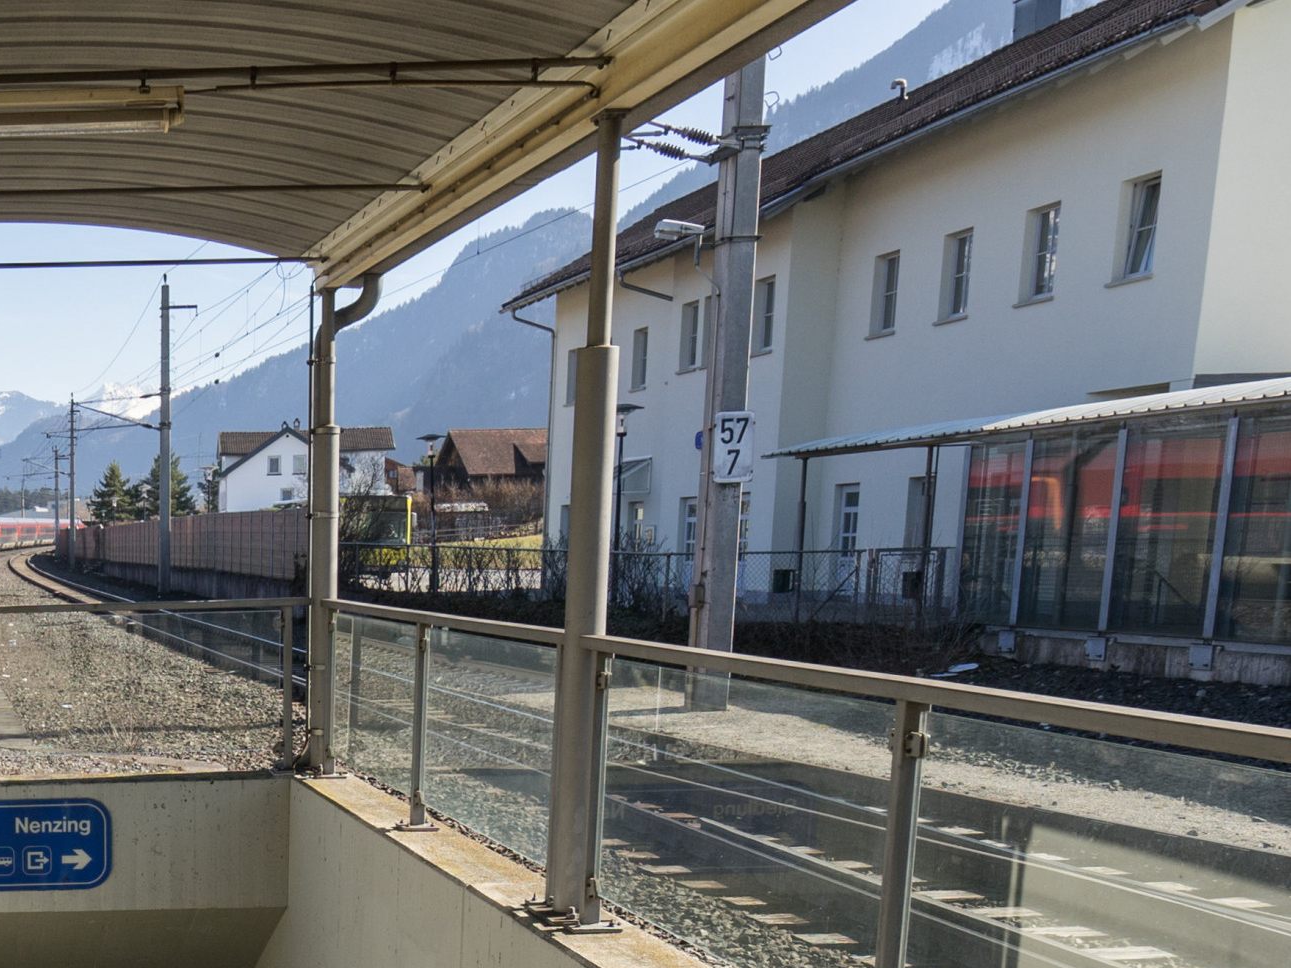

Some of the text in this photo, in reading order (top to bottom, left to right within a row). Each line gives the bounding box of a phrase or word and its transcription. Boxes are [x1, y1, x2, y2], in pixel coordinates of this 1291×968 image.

[721, 417, 749, 444] 57
[727, 449, 740, 475] 7
[14, 816, 91, 836] Nenzing
